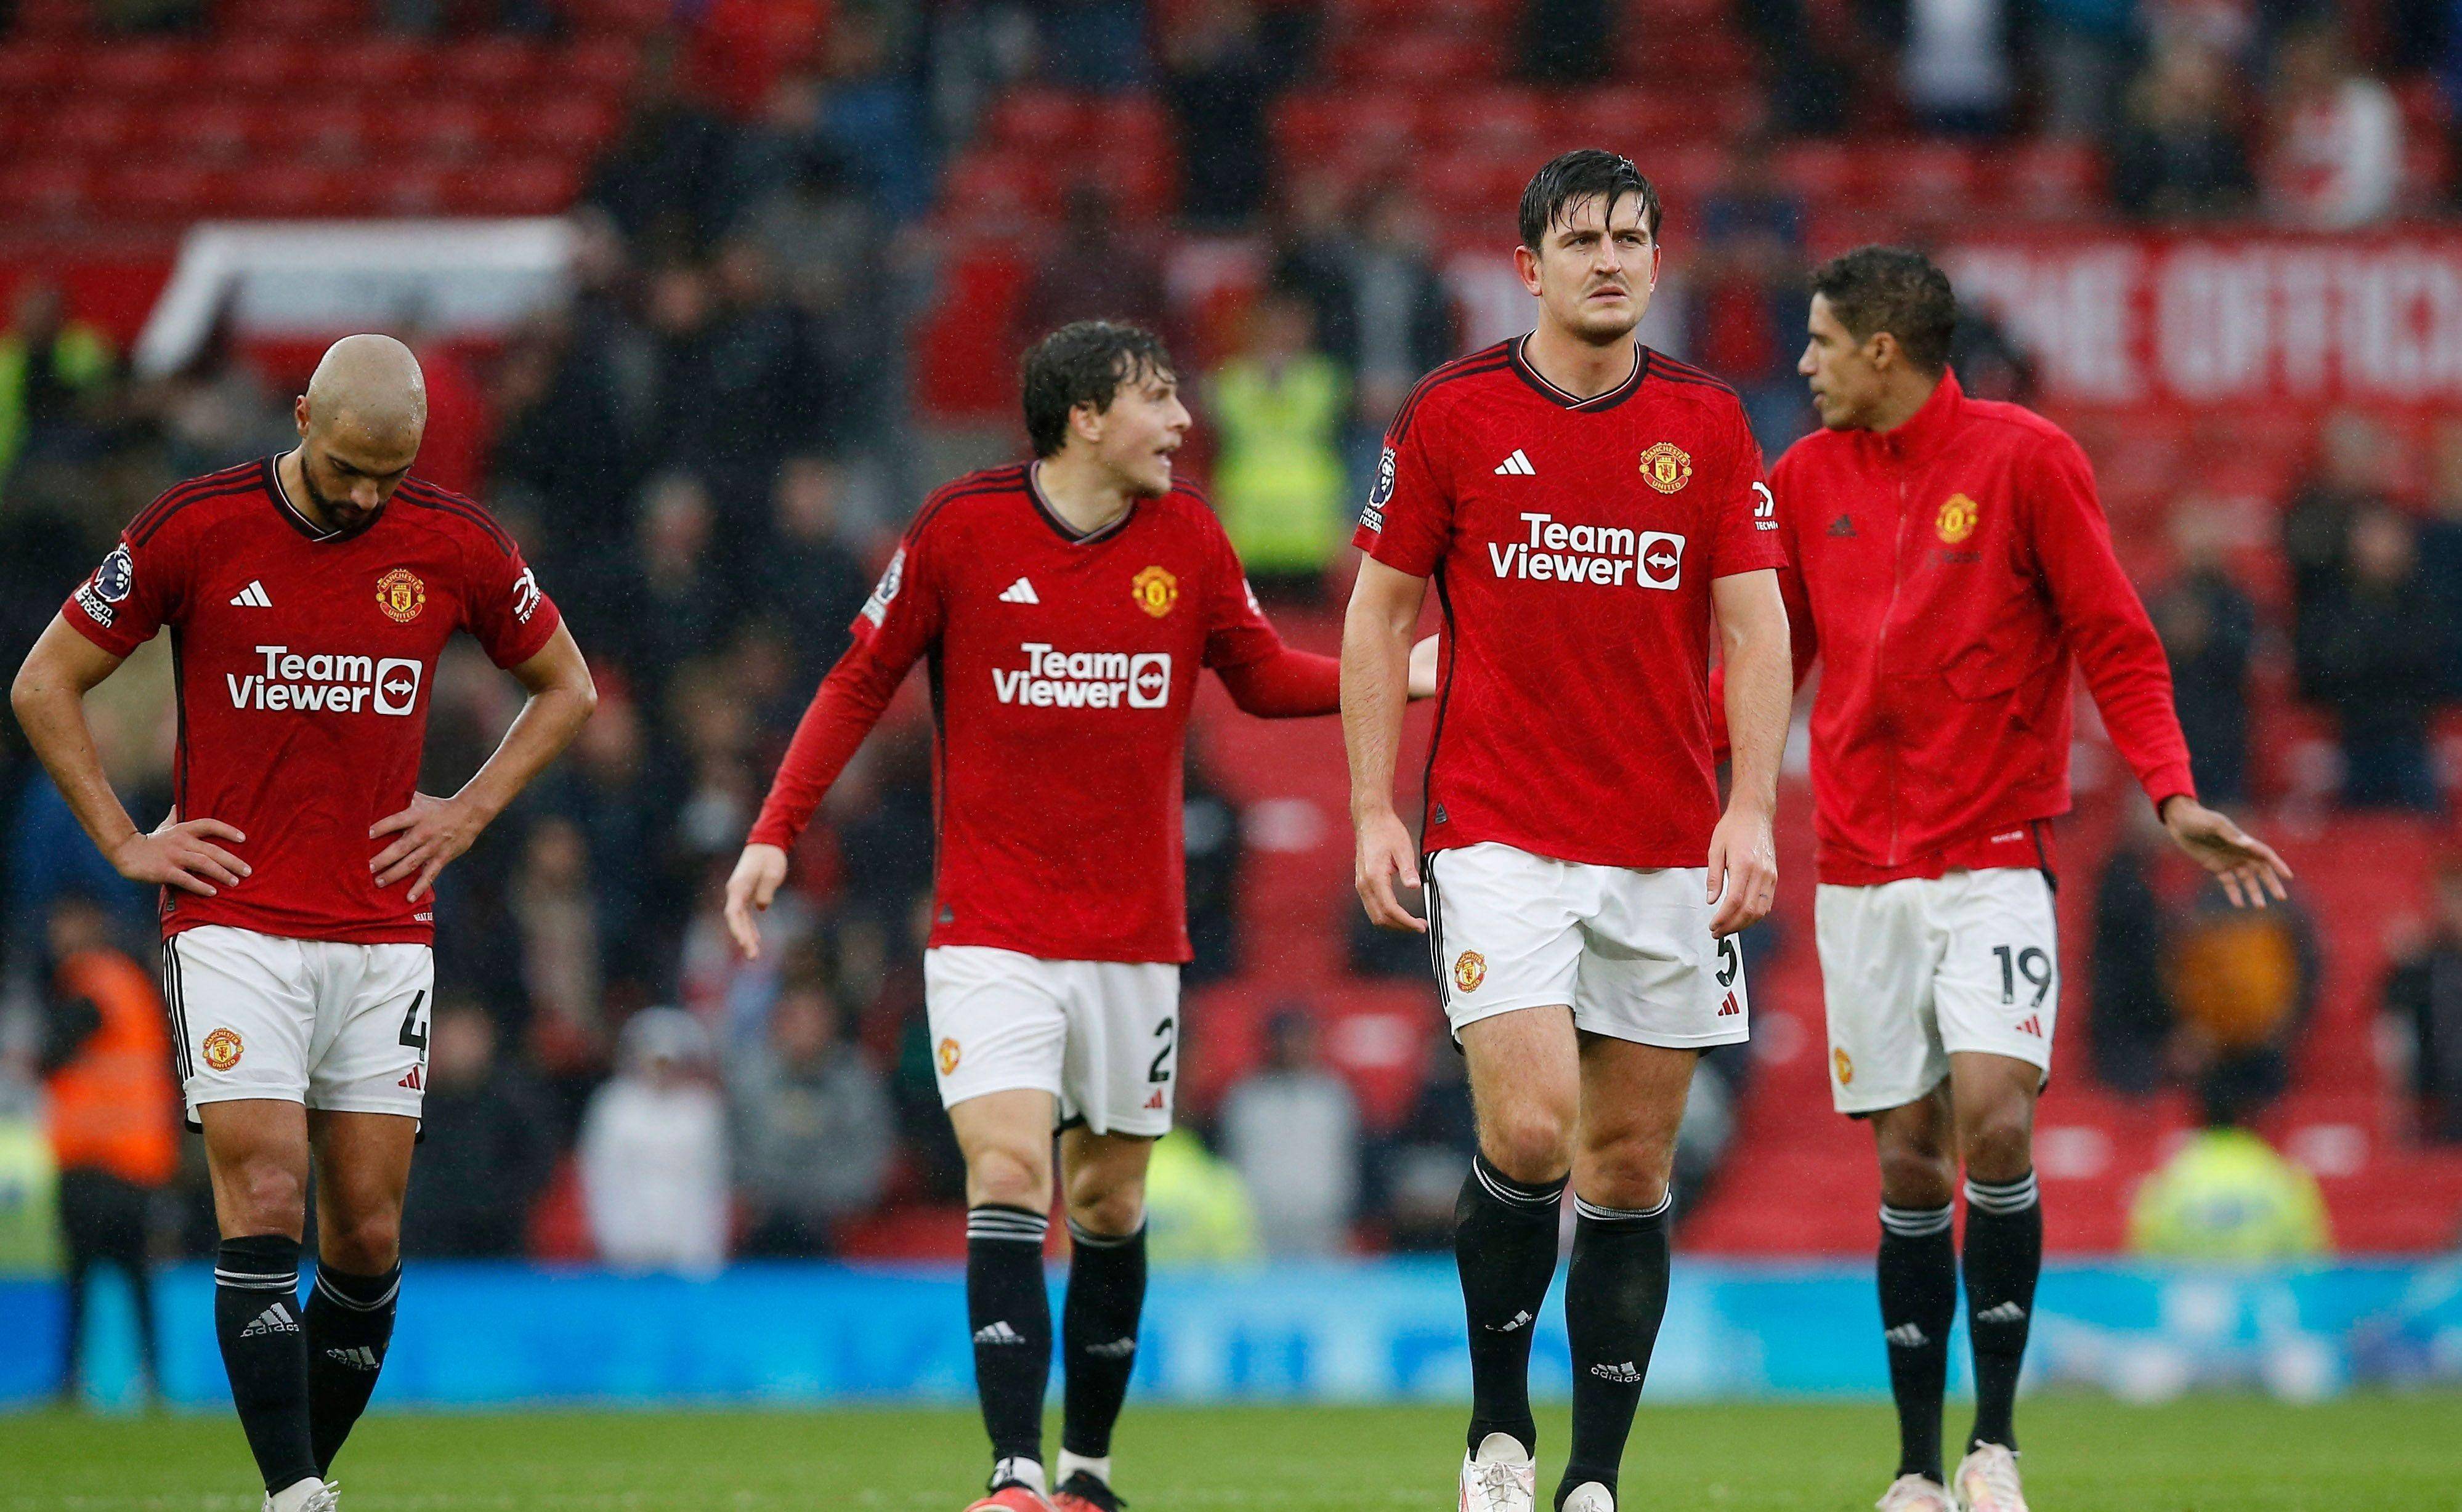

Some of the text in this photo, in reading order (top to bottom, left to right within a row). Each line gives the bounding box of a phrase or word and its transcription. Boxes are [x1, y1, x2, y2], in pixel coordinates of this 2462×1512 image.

[1645, 446, 1687, 464] MANCHESTER
[1652, 480, 1681, 490] UNITED
[1520, 512, 1634, 556] Team
[381, 573, 421, 591] MANCHESTER
[1488, 542, 1632, 586] Viewer
[388, 609, 416, 619] UNITED
[255, 645, 372, 682] Team
[1021, 642, 1129, 679] Team
[227, 673, 370, 713] Viewer
[991, 668, 1127, 708] Viewer
[1715, 937, 1737, 987] 5
[1993, 946, 2051, 1008] 19
[399, 989, 427, 1062] 4
[213, 1059, 236, 1068] UNITED
[1149, 1017, 1172, 1083] 2
[240, 1322, 299, 1337] adidas
[1591, 1367, 1641, 1383] adidas
